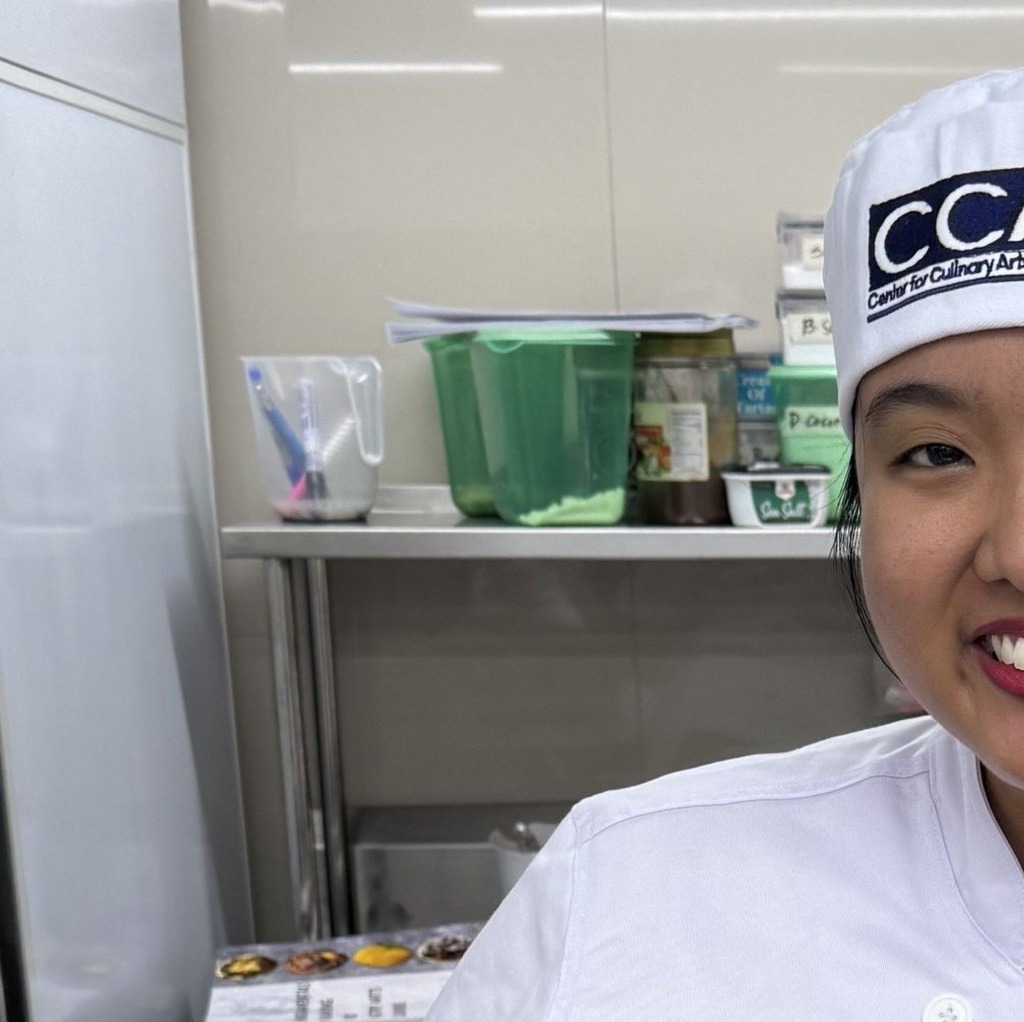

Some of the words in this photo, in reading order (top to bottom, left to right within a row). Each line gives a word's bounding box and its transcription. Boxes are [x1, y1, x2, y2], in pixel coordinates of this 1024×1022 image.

[867, 283, 908, 310] Center
[909, 274, 929, 292] for
[930, 258, 995, 278] Culinary
